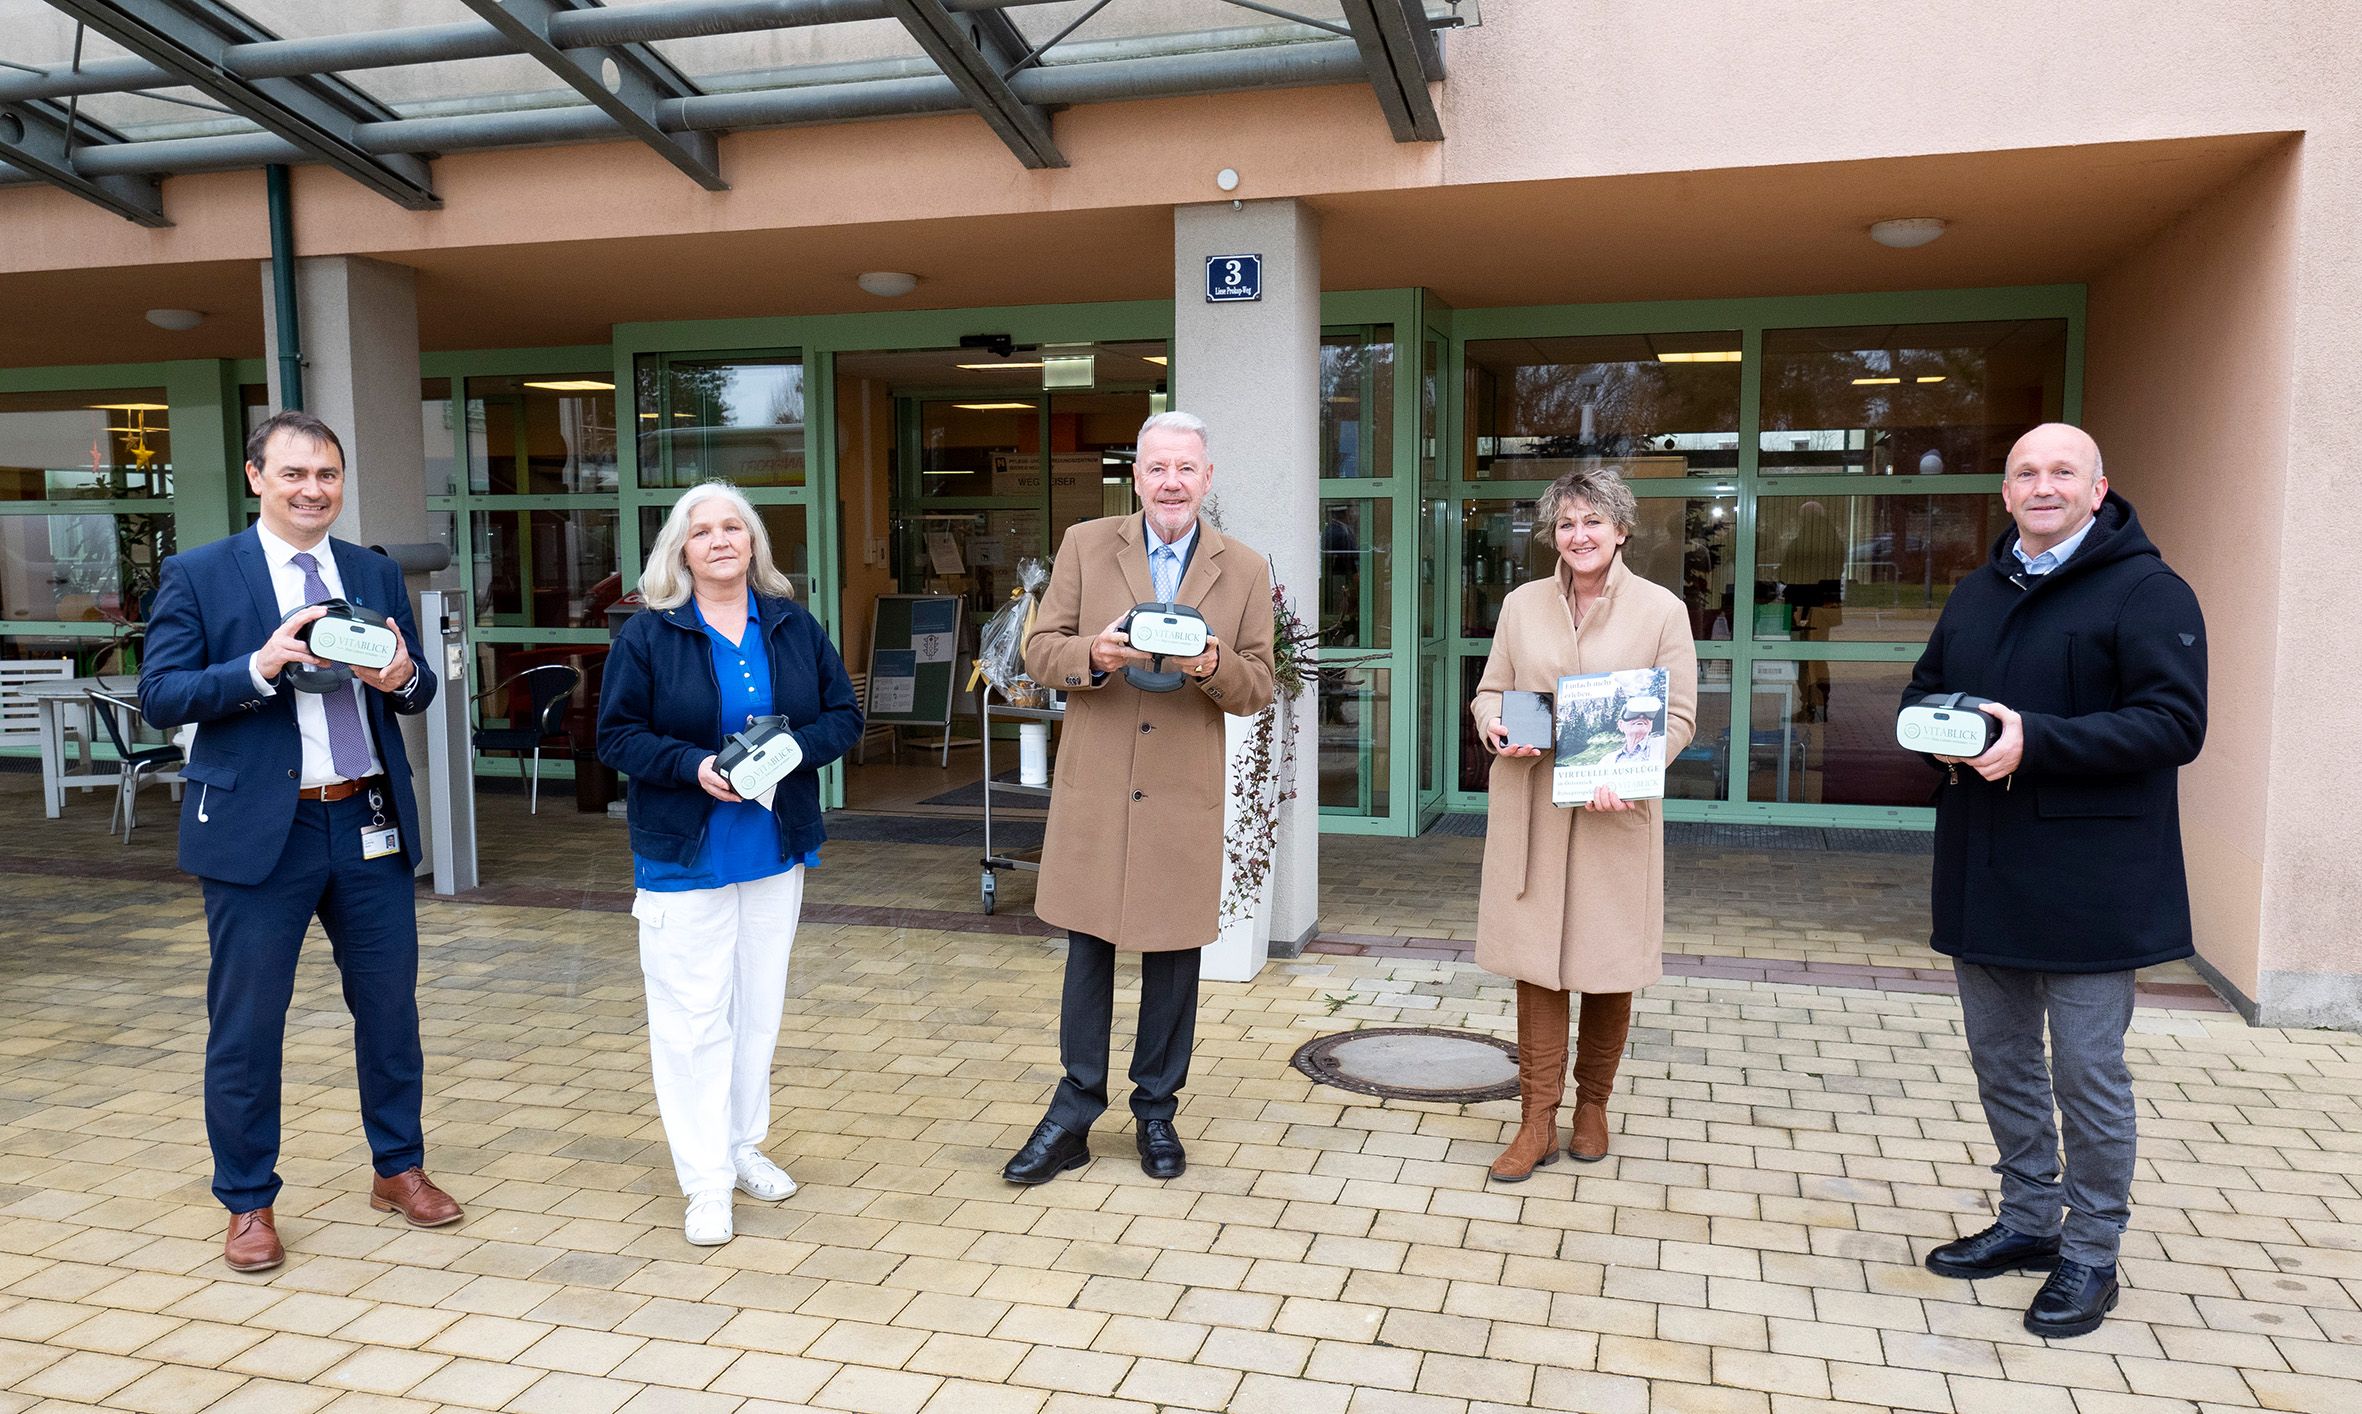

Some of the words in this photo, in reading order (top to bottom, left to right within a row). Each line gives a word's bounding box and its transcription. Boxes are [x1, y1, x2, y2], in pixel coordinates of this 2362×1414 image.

[1224, 260, 1242, 286] 3
[1018, 477, 1077, 486] WEGEISER
[1155, 629, 1200, 642] VITABLICK
[339, 636, 389, 655] VITABLICK
[1923, 726, 1977, 741] VITABLICK
[753, 745, 794, 777] VITABLICK
[1558, 769, 1609, 779] VIRTUELLE
[1612, 764, 1660, 776] AUSFLÜGE
